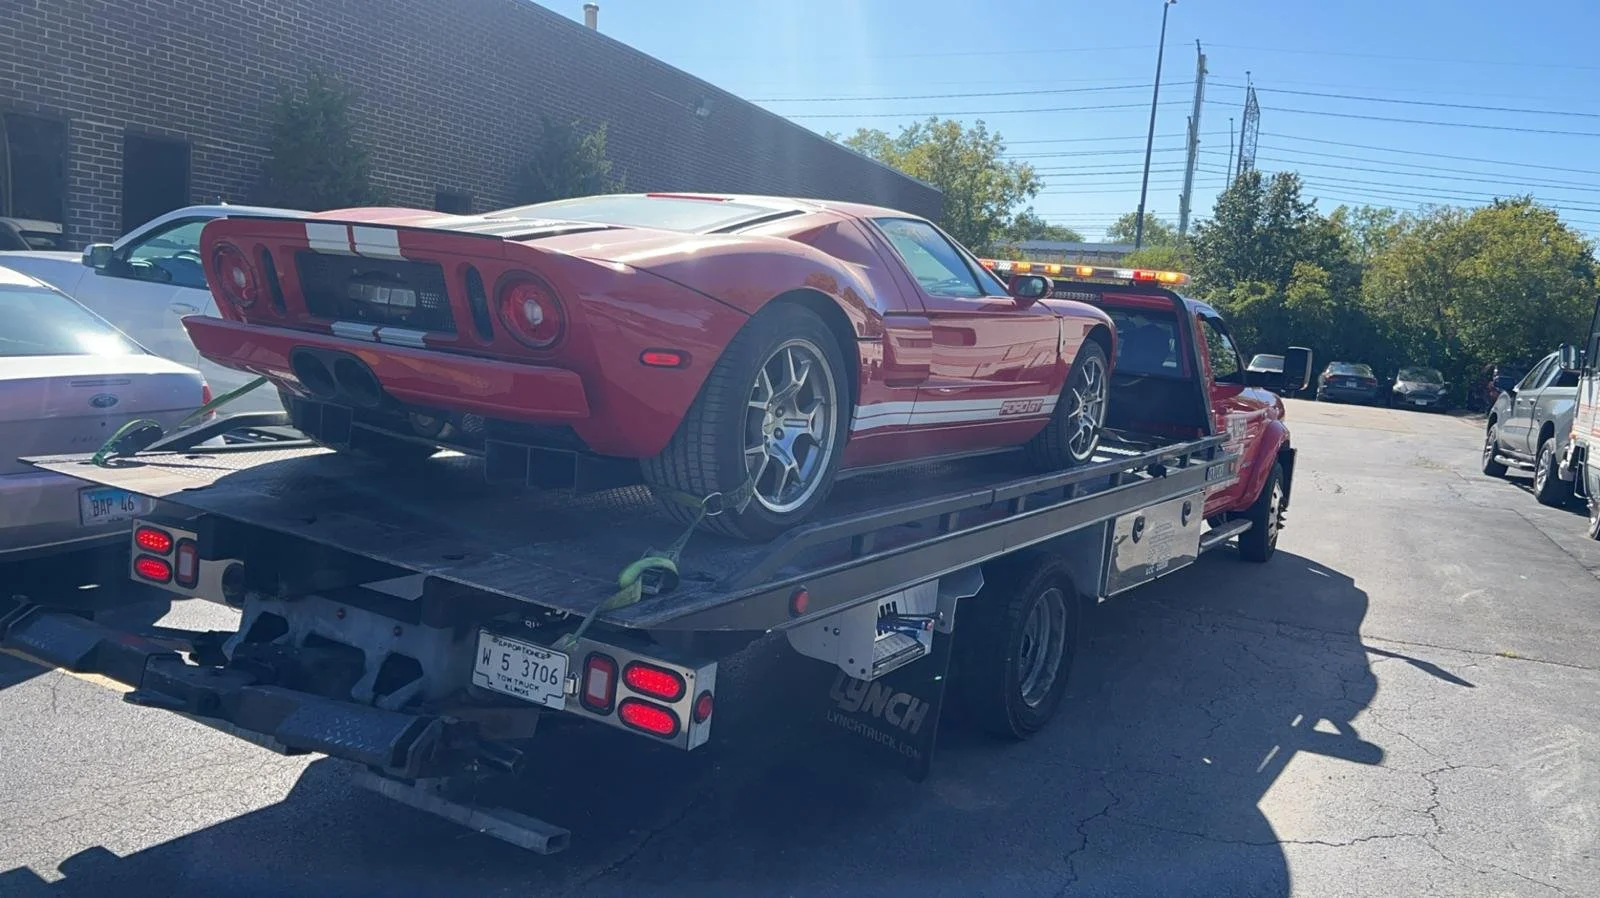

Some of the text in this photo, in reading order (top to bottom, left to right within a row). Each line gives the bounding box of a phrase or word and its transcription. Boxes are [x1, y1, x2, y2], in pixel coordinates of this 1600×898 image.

[999, 399, 1044, 416] FORD GT
[93, 495, 135, 517] BAP 46
[482, 647, 558, 685] W 5 3706
[497, 673, 540, 691] TOW TRUCK
[829, 673, 930, 734] LYNCH
